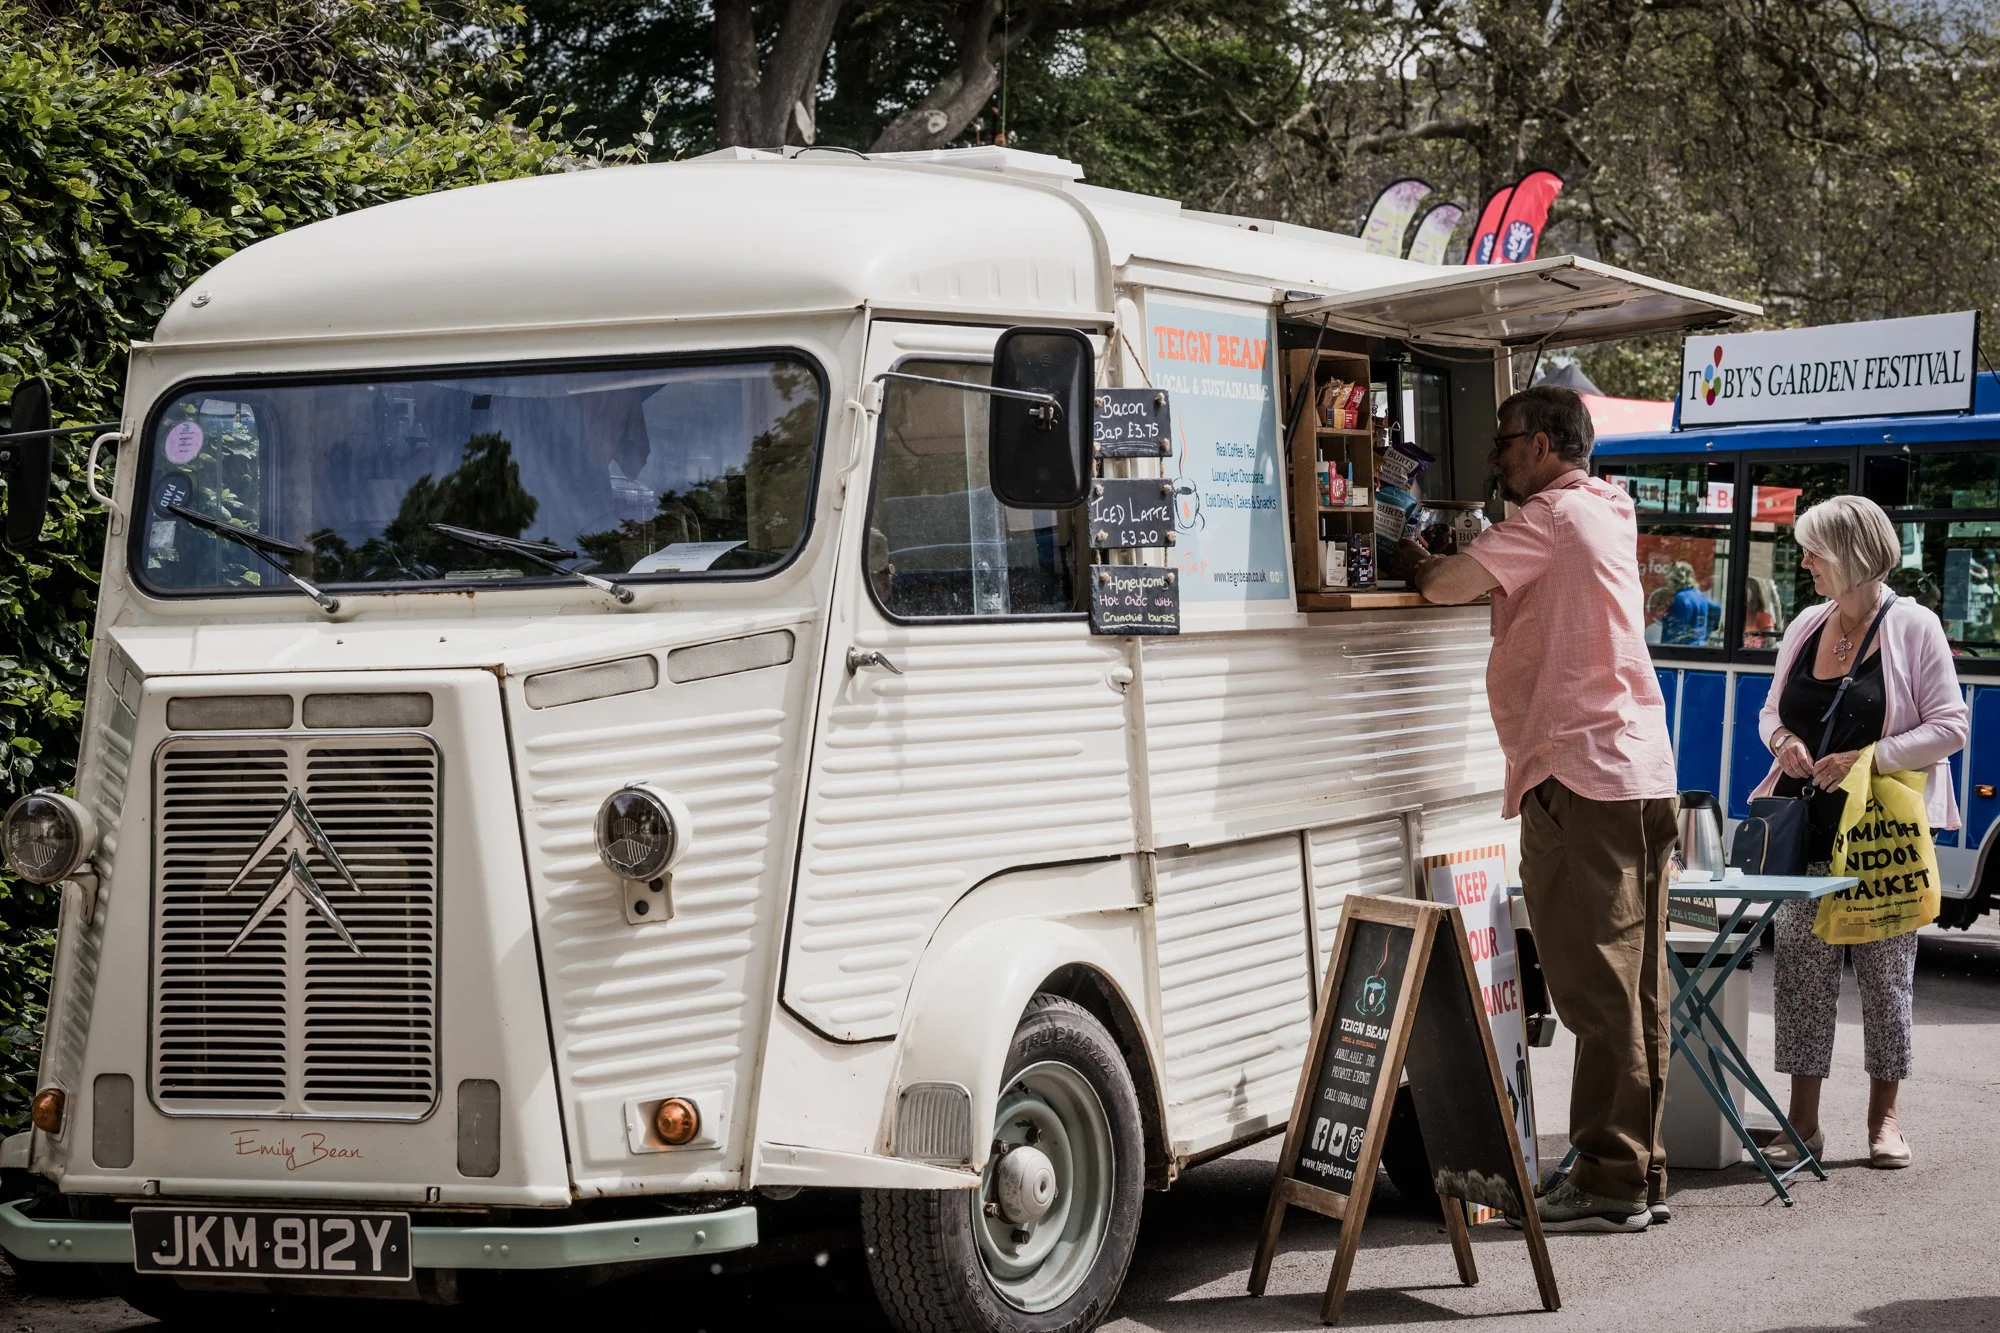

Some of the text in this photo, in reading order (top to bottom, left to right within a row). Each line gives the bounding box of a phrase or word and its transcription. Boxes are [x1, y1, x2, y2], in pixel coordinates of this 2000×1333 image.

[1154, 325, 1267, 370] TEIGN BEAN
[1768, 359, 1859, 396] GARDEN
[1862, 350, 1965, 389] FESTIVAL
[1156, 373, 1270, 402] LOCAL & SUSTAINABLE
[1100, 395, 1147, 418] Bacon
[1094, 421, 1159, 440] Bap £3.75
[1215, 442, 1227, 457] Real
[1227, 443, 1243, 458] Coffee
[1246, 444, 1255, 459] Tea
[1387, 450, 1416, 469] BURTS
[1212, 467, 1230, 487] Luxury
[1239, 469, 1264, 484] Chocolate
[1256, 495, 1277, 510] Snacks
[1377, 503, 1404, 518] BURTS
[1121, 530, 1158, 546] £3.20
[1213, 568, 1267, 587] www.teignbean.co.uk
[1100, 593, 1119, 607] Hot
[1154, 597, 1173, 608] with
[1454, 870, 1488, 906] KEEP
[1468, 926, 1499, 963] OUR
[1340, 1018, 1389, 1041] TEIGN BEAN
[230, 1129, 363, 1170] Emily Bean
[1302, 1158, 1356, 1181] www.teignbean.co.
[152, 1215, 392, 1271] JKM 812Y
